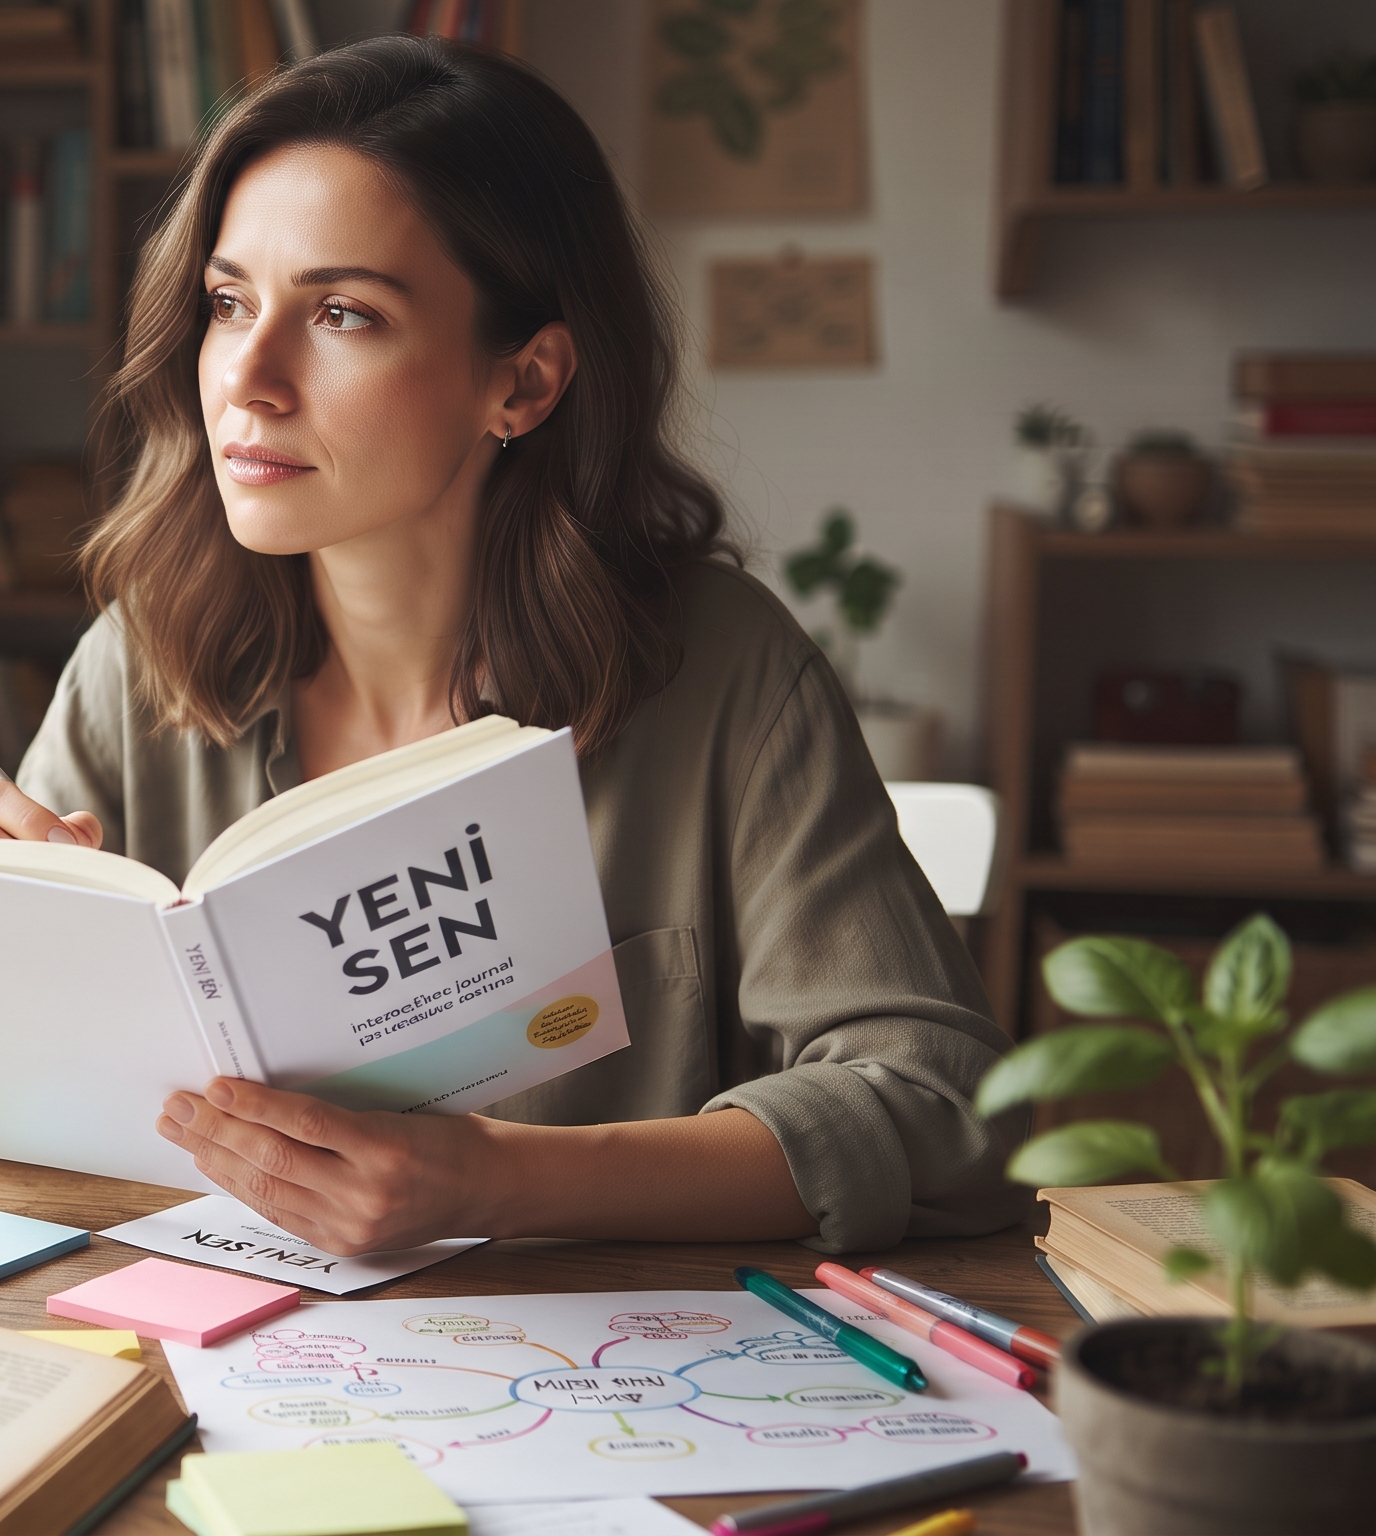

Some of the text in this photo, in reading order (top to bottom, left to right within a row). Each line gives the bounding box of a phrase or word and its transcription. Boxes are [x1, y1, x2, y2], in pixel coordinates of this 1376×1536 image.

[342, 897, 499, 996] SEN
[456, 956, 514, 994] journal
[180, 1228, 256, 1252] SEN
